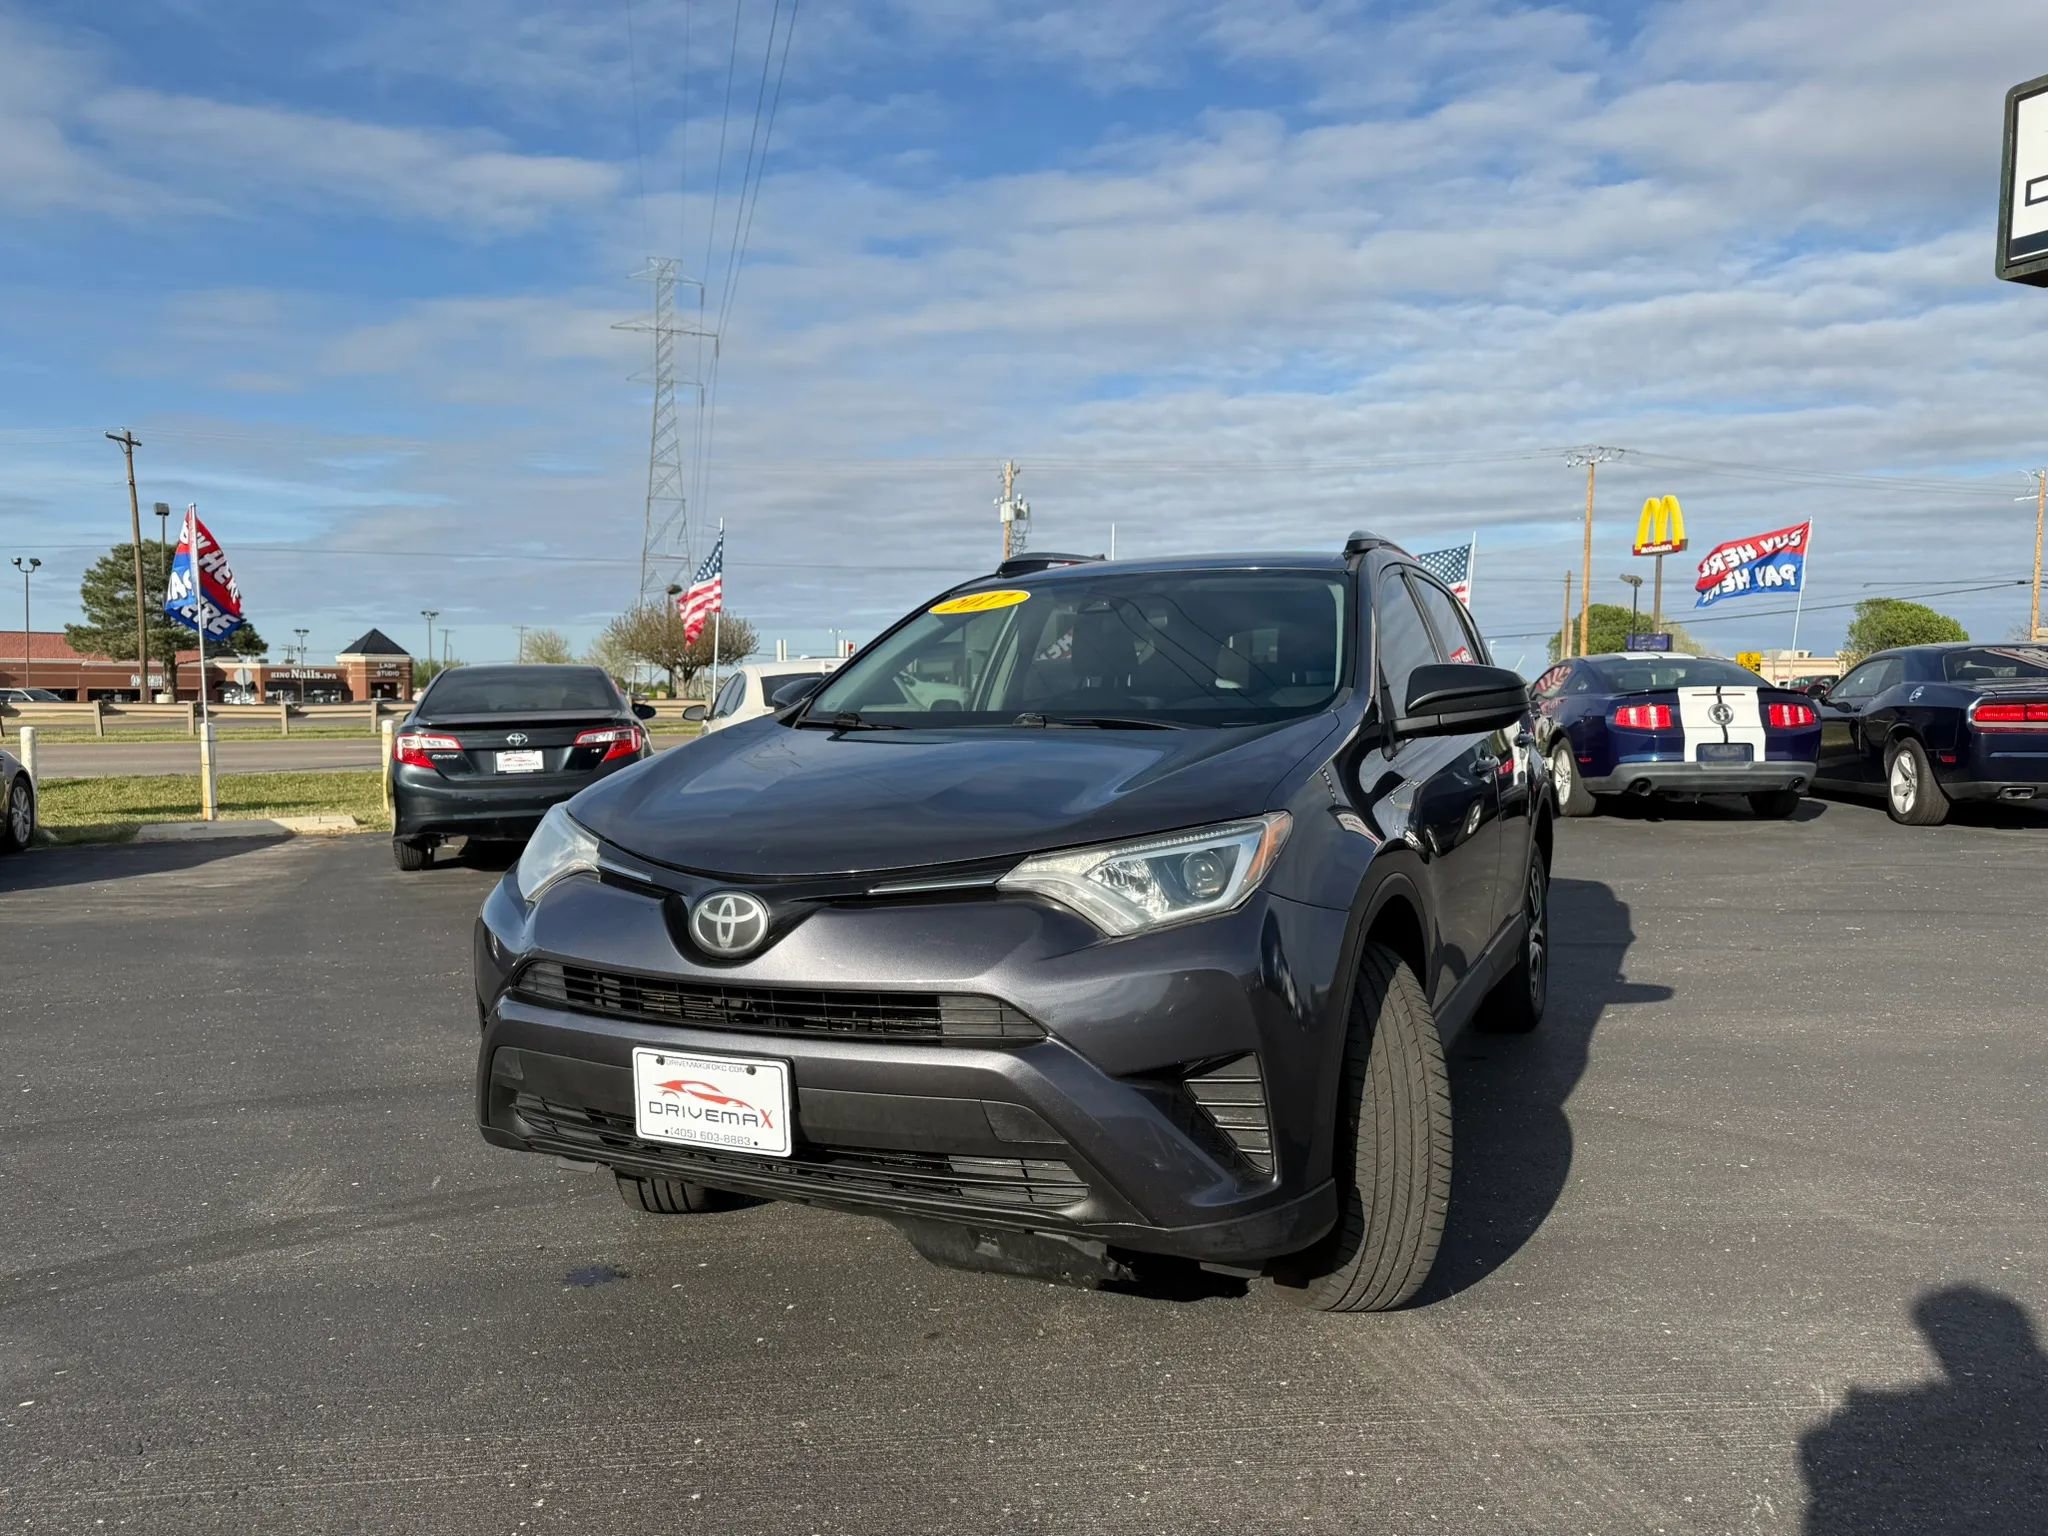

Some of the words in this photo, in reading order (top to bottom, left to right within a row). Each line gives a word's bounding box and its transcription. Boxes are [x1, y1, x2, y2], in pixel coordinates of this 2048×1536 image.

[291, 669, 320, 679] Nails
[649, 1101, 773, 1129] DRIVEMAX
[670, 1127, 697, 1139] (405)
